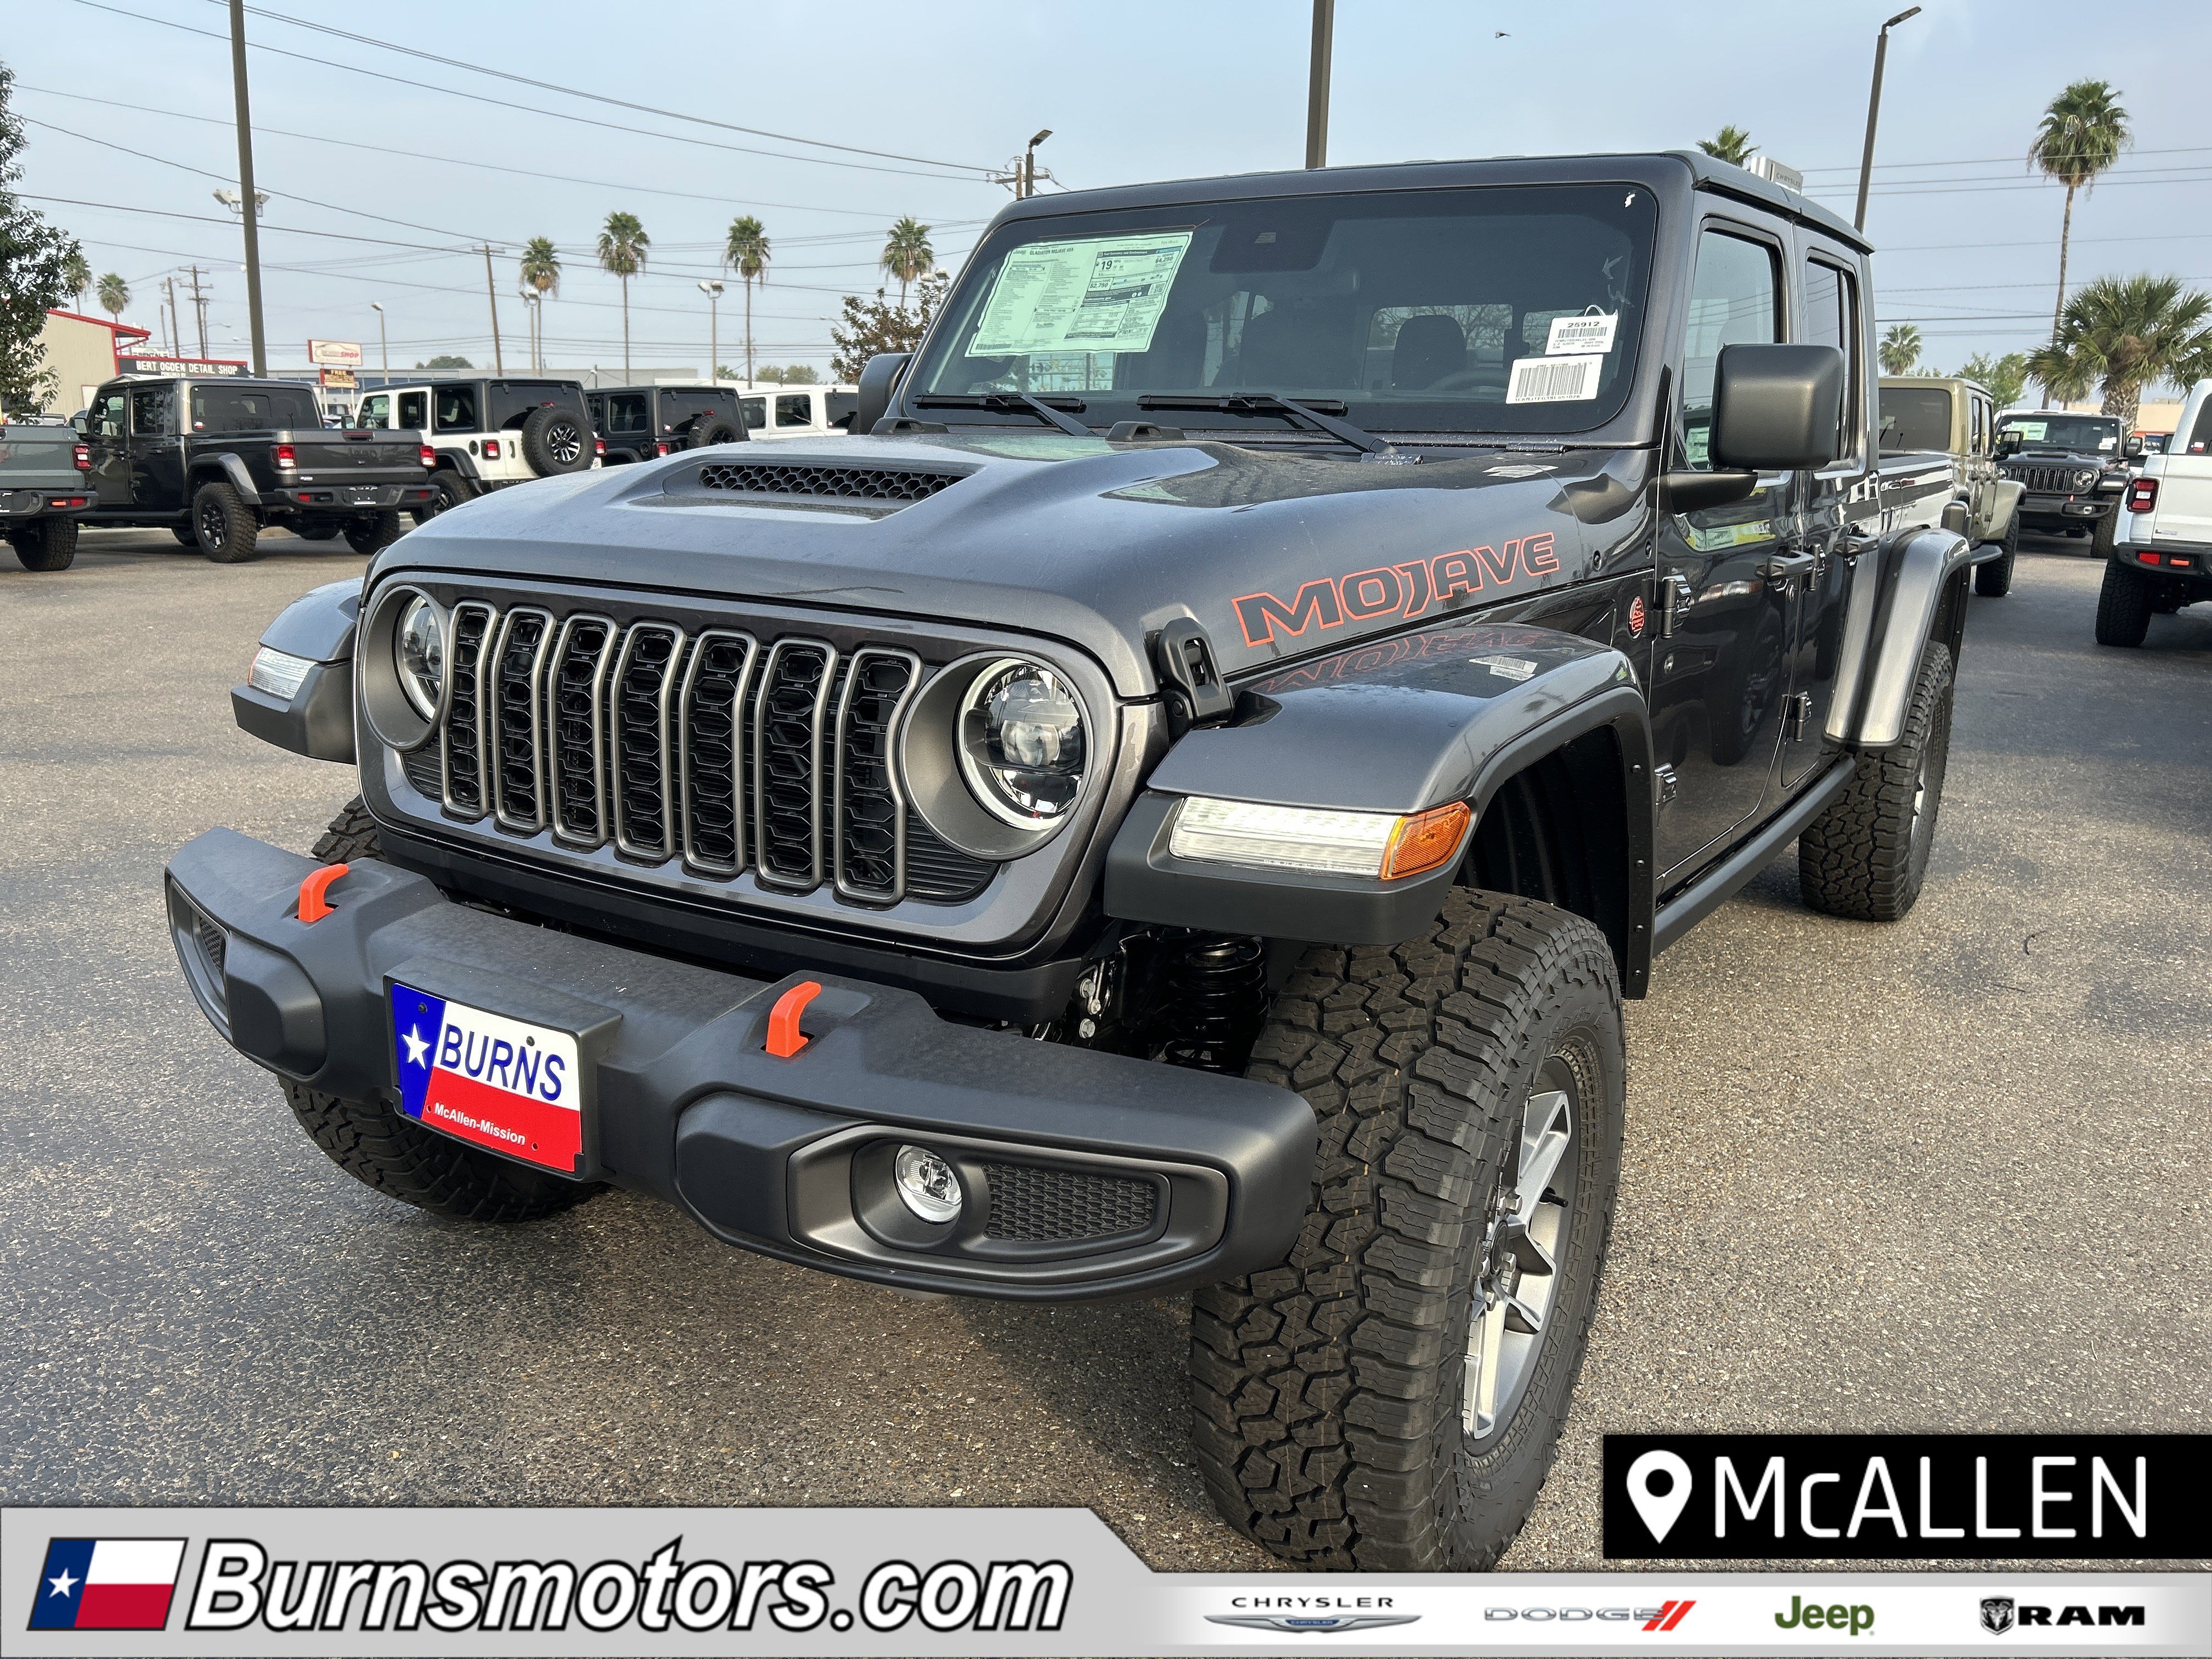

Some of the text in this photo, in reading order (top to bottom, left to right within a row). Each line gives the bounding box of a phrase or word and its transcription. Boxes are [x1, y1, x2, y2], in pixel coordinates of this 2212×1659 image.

[1102, 260, 1113, 270] 19
[136, 360, 238, 375] BERT OGDEN DETAIL SHOP
[1231, 532, 1559, 647] MOJAVE
[439, 1023, 566, 1101] BURNS
[434, 1102, 526, 1146] McAllen-Mission
